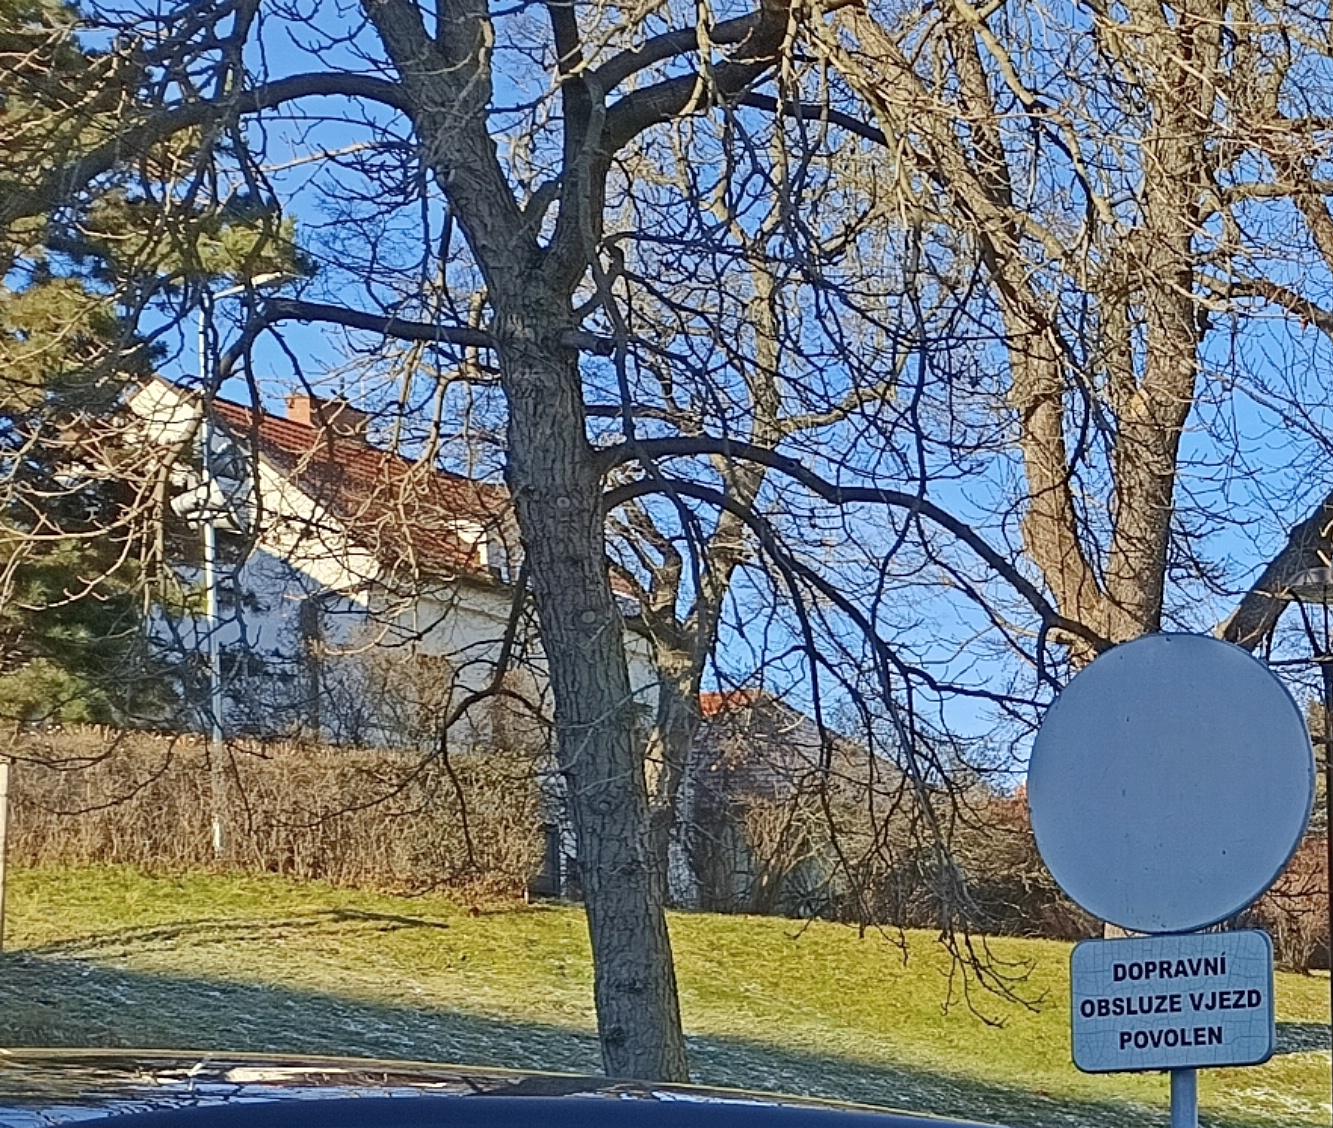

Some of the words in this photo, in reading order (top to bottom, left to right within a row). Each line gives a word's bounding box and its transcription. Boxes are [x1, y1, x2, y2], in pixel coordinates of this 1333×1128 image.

[1113, 952, 1226, 982] DOPRAVNÍ
[1080, 994, 1182, 1018] OBSLUZE
[1189, 989, 1262, 1012] VJEZD
[1119, 1026, 1223, 1050] POVOLEN
